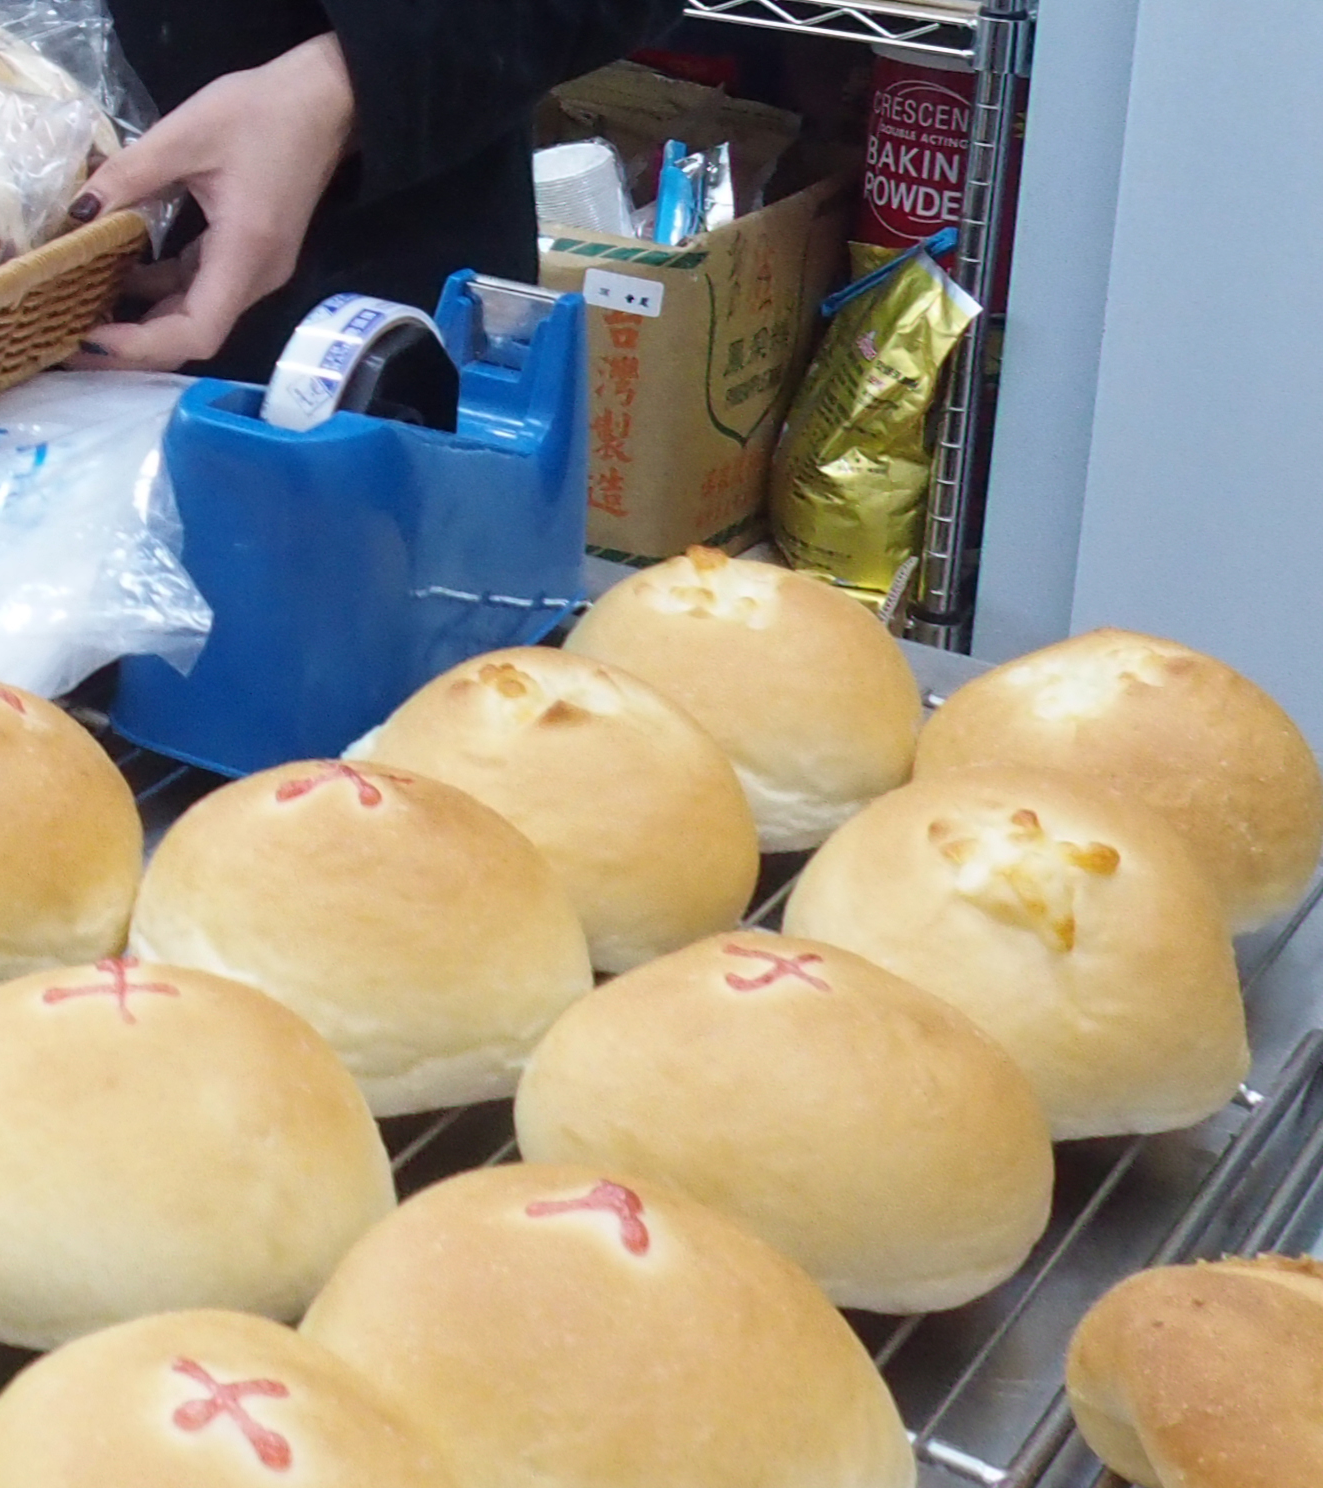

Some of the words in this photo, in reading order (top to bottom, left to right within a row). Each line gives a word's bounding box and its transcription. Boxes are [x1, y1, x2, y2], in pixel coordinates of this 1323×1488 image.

[873, 91, 970, 133] CRESCEN
[866, 135, 960, 184] BAKIN
[920, 134, 970, 150] ACTING
[864, 171, 963, 221] POWDE
[588, 312, 643, 518] 台灣製造
